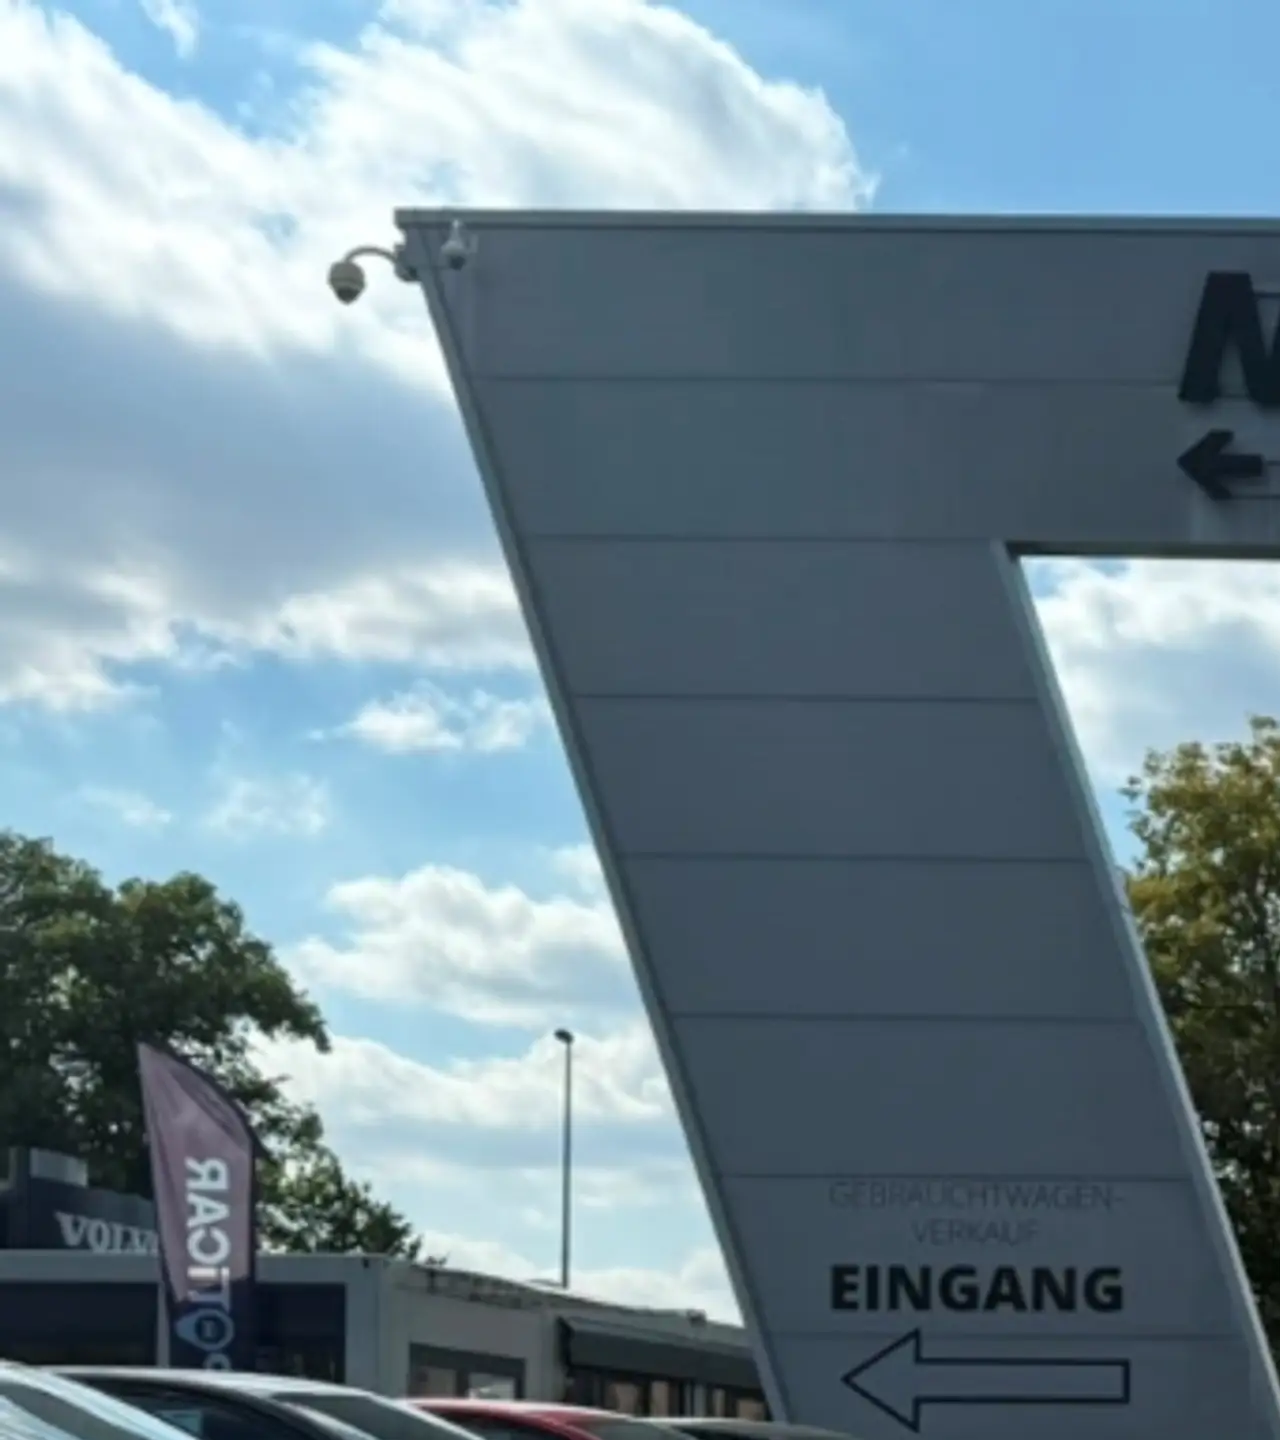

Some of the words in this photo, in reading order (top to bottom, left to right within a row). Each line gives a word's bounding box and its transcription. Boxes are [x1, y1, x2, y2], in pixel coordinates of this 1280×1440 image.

[53, 1210, 159, 1256] VOLV
[911, 1217, 1039, 1246] VERKAUF
[830, 1263, 1124, 1312] EINGANG
